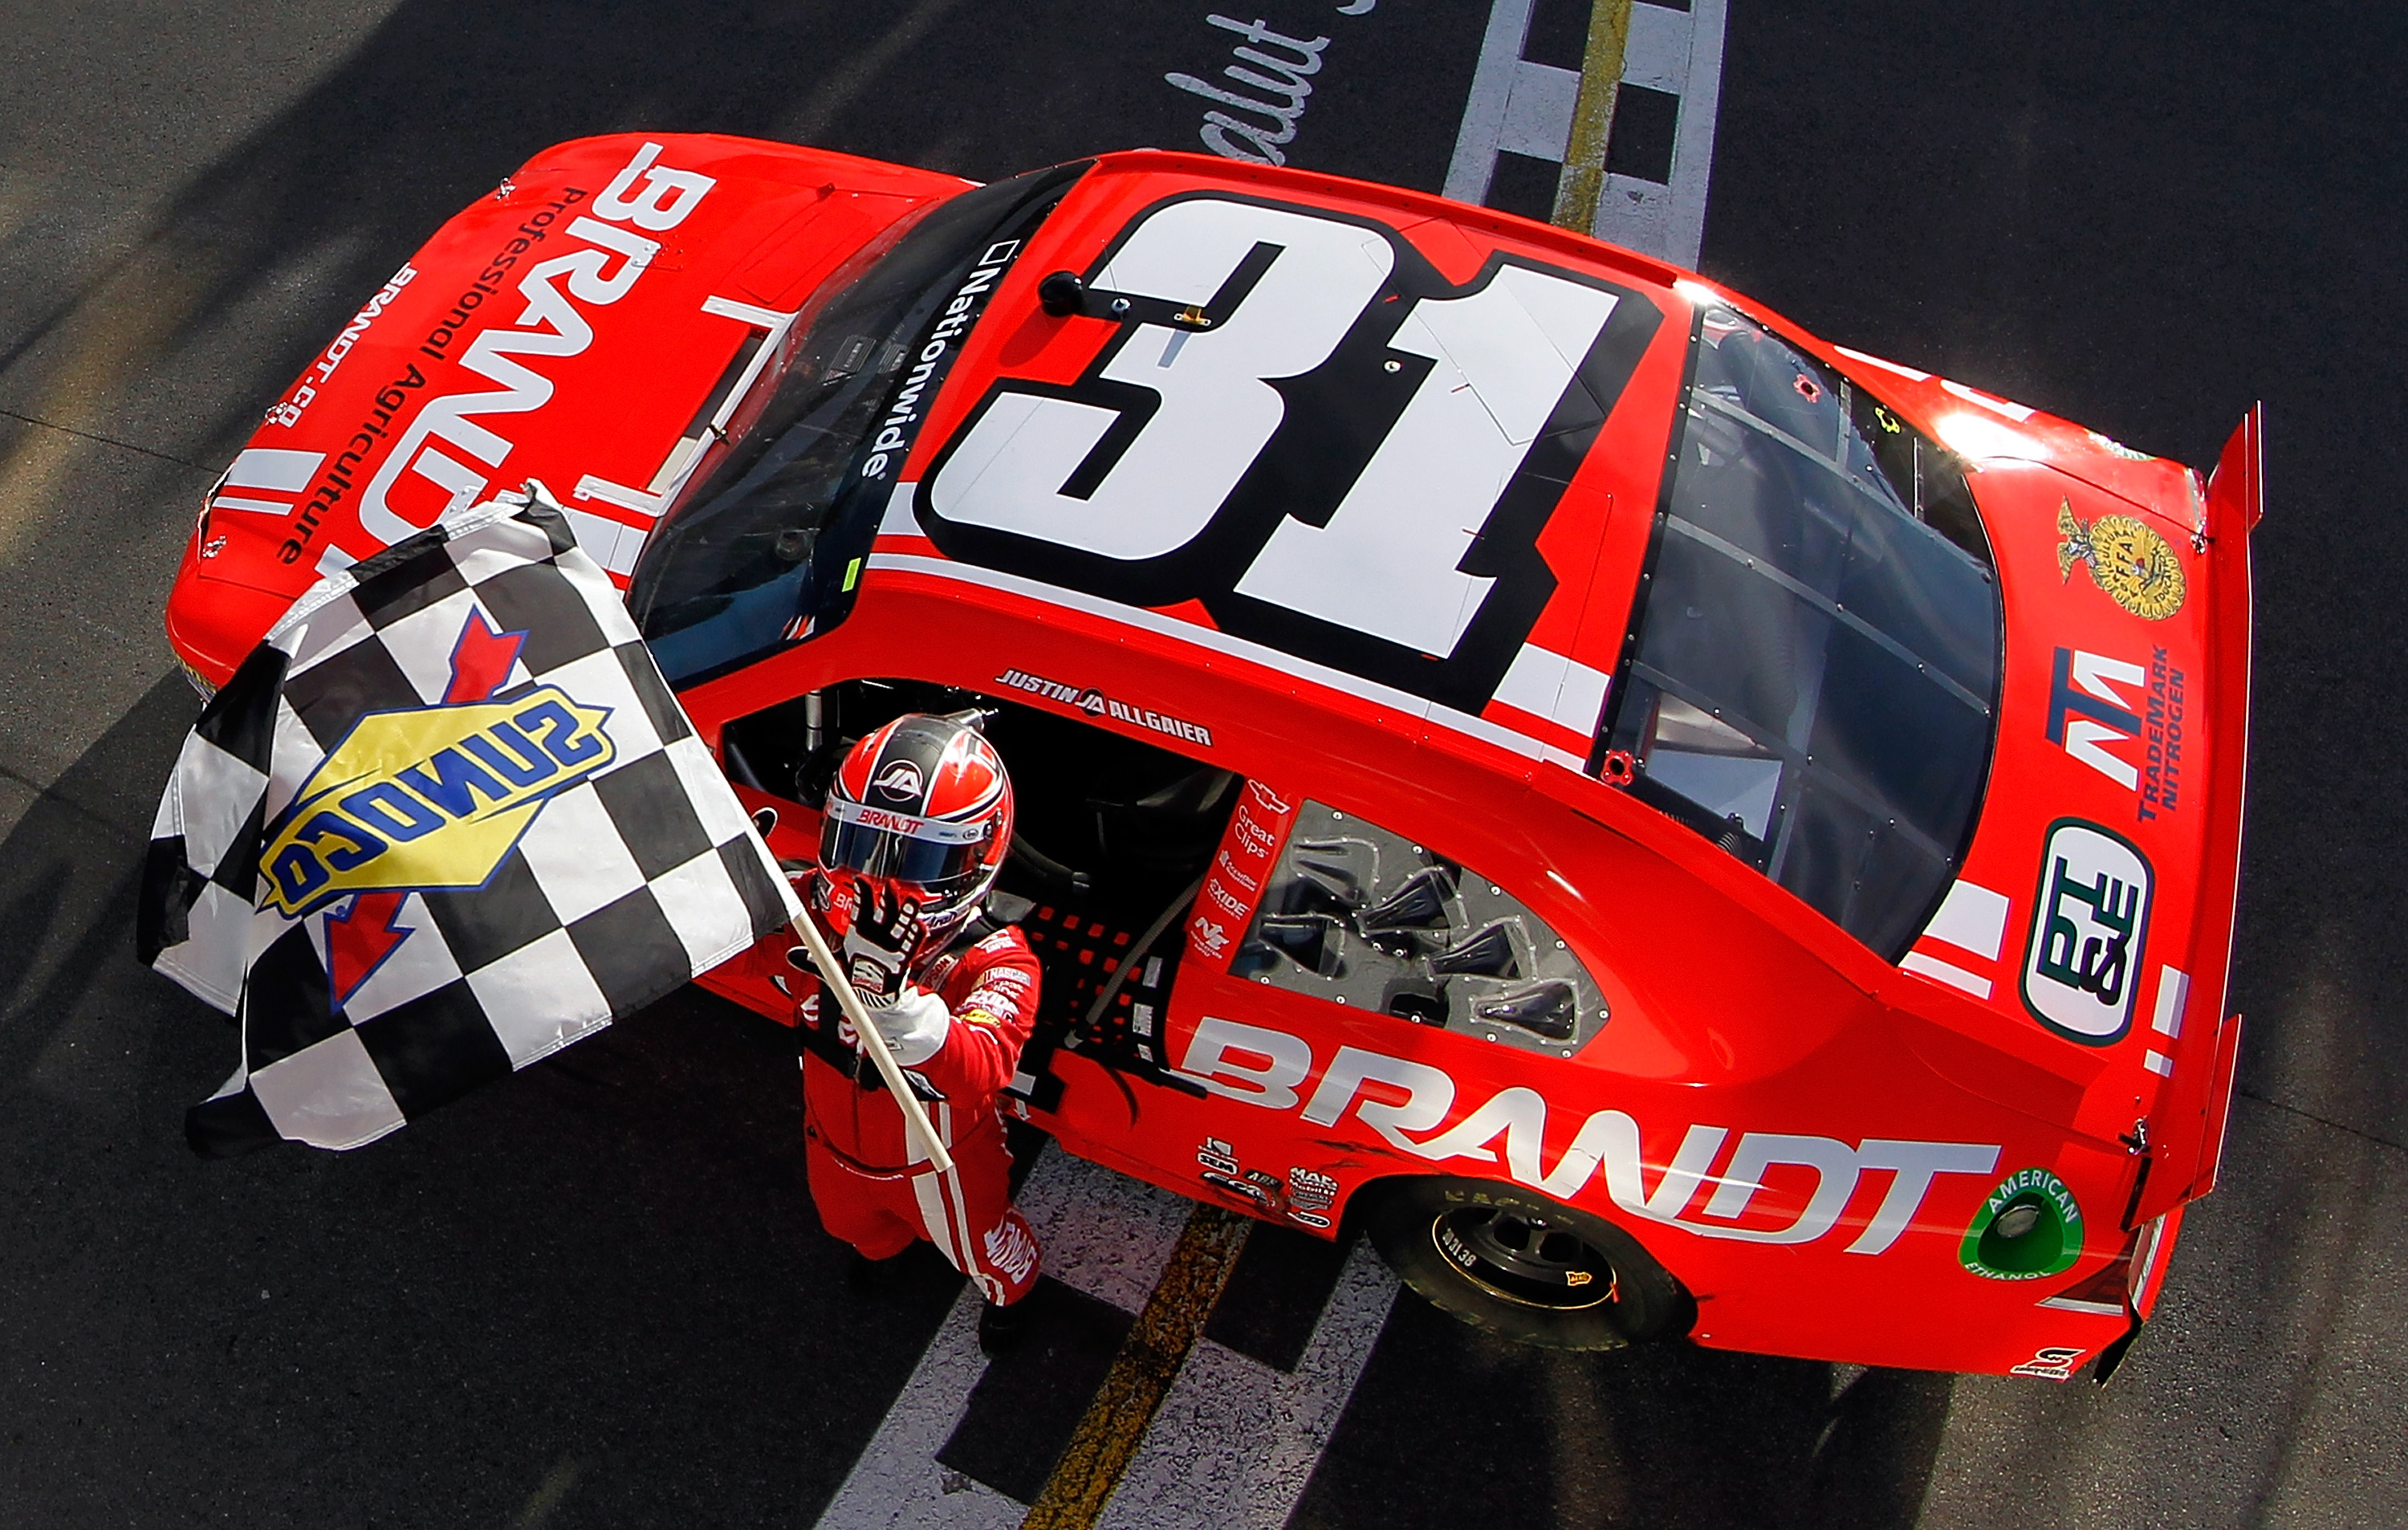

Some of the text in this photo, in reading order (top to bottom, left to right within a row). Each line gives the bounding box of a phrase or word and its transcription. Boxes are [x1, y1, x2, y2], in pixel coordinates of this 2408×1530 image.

[278, 185, 588, 565] Professional Agriculture
[861, 267, 1006, 480] Nationwide
[931, 199, 1619, 660] 31
[2115, 541, 2133, 578] FFA
[995, 669, 1077, 704] JUSTIN
[1108, 700, 1214, 747] ALLGAIER
[2162, 668, 2185, 813] NITROGEN
[872, 768, 923, 797] JA
[856, 808, 925, 835] BRANDT
[1235, 823, 1267, 858] Clips
[1239, 805, 1277, 847] Great
[1210, 879, 1250, 918] EXIDE
[1181, 1017, 2002, 1255] BRANDT
[1987, 1169, 2077, 1224] AMERICAN
